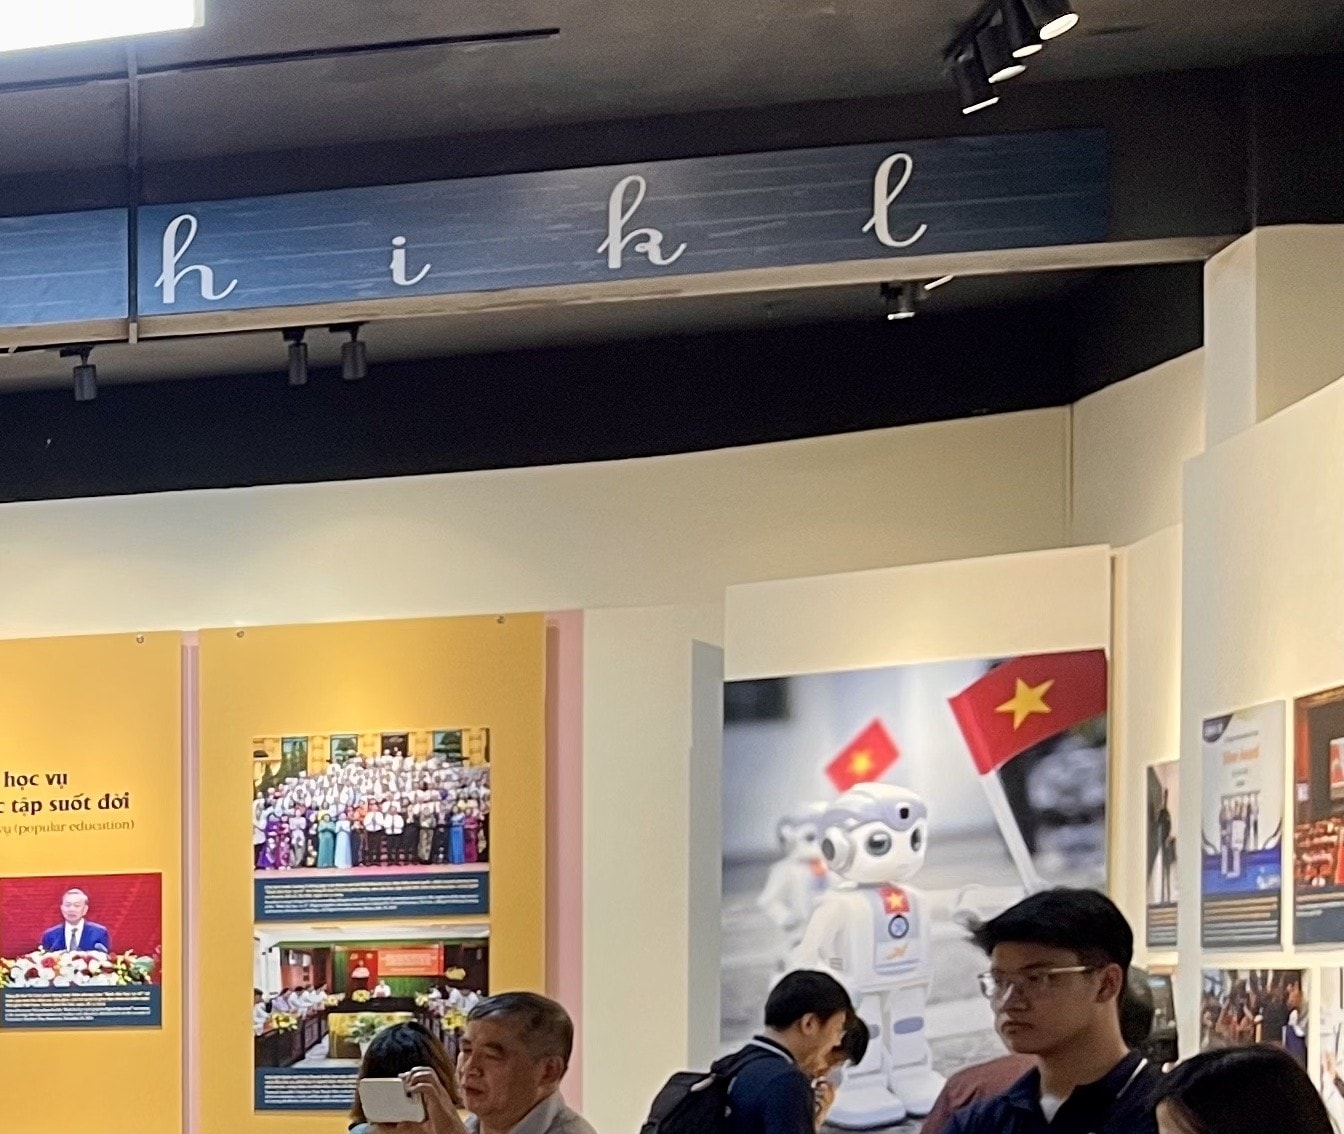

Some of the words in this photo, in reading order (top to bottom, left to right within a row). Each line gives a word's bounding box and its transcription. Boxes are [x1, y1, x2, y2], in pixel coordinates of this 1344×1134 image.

[154, 212, 238, 305] h
[391, 234, 432, 287] i
[598, 173, 687, 270] k
[863, 151, 927, 248] l
[4, 771, 40, 790] học
[46, 773, 68, 790] vụ
[12, 797, 42, 816] tập
[49, 793, 91, 812] suốt
